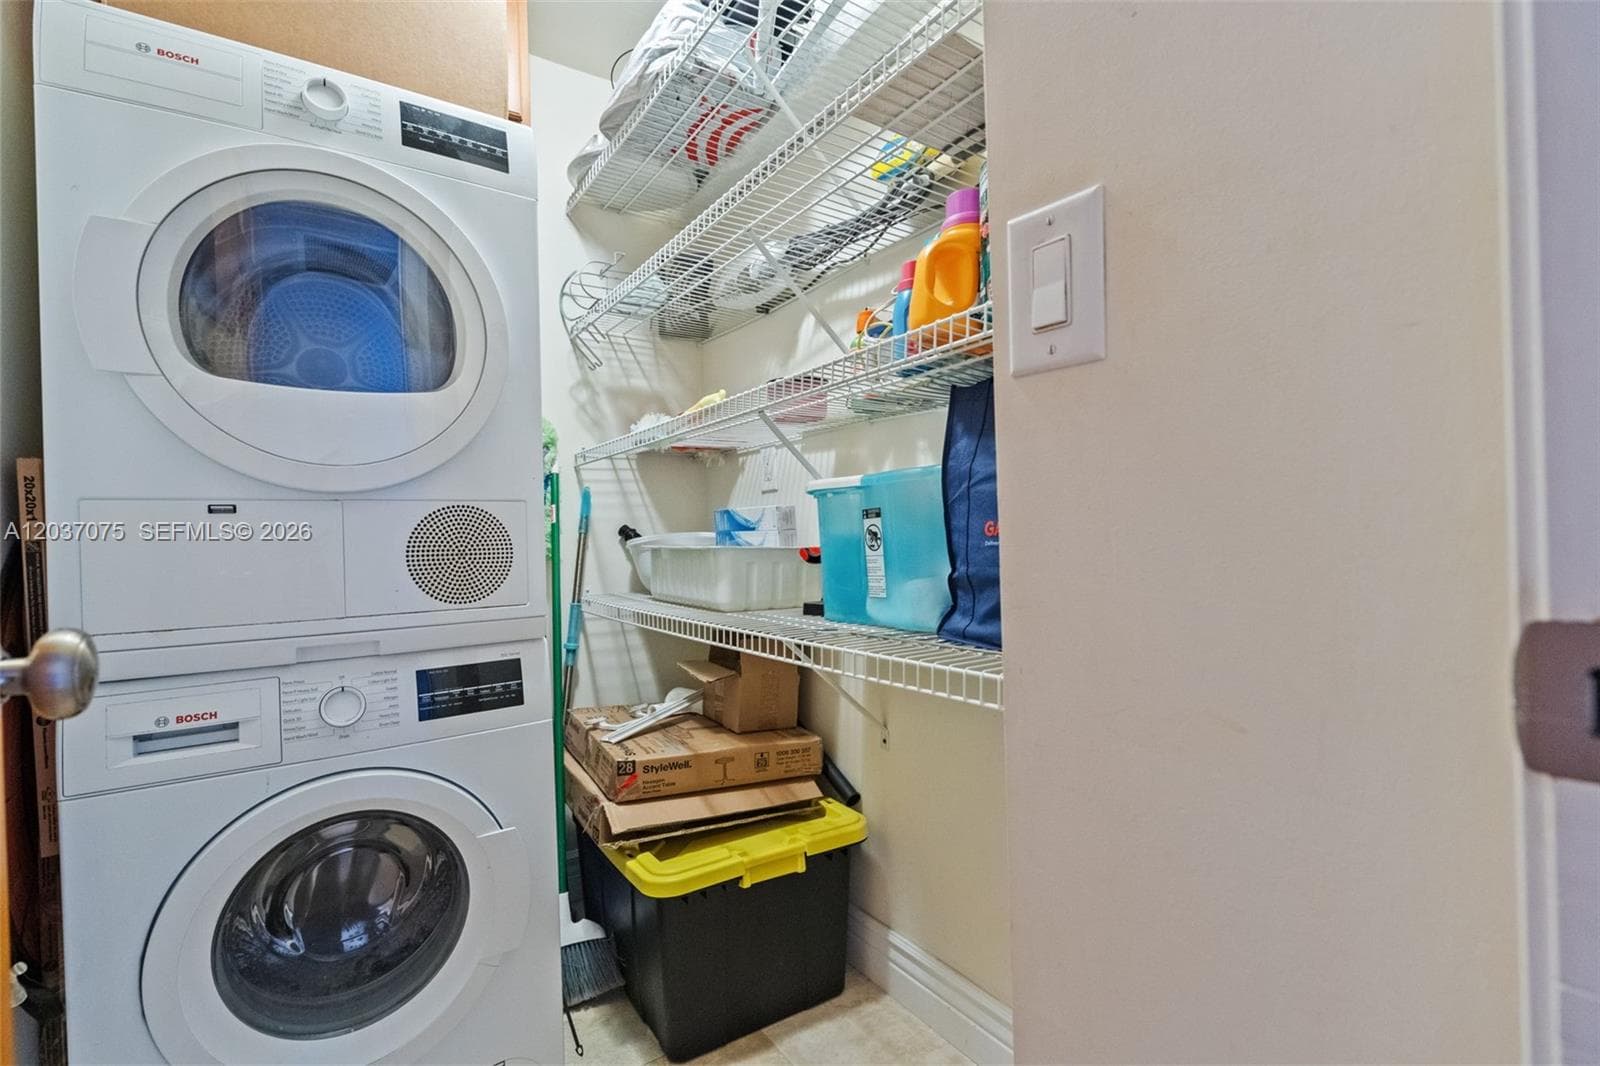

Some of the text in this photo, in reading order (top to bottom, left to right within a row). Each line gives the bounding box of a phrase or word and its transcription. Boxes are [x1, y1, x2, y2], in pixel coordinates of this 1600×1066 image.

[157, 48, 199, 64] BOSCH
[176, 711, 217, 723] BOSCH
[619, 763, 633, 774] 28
